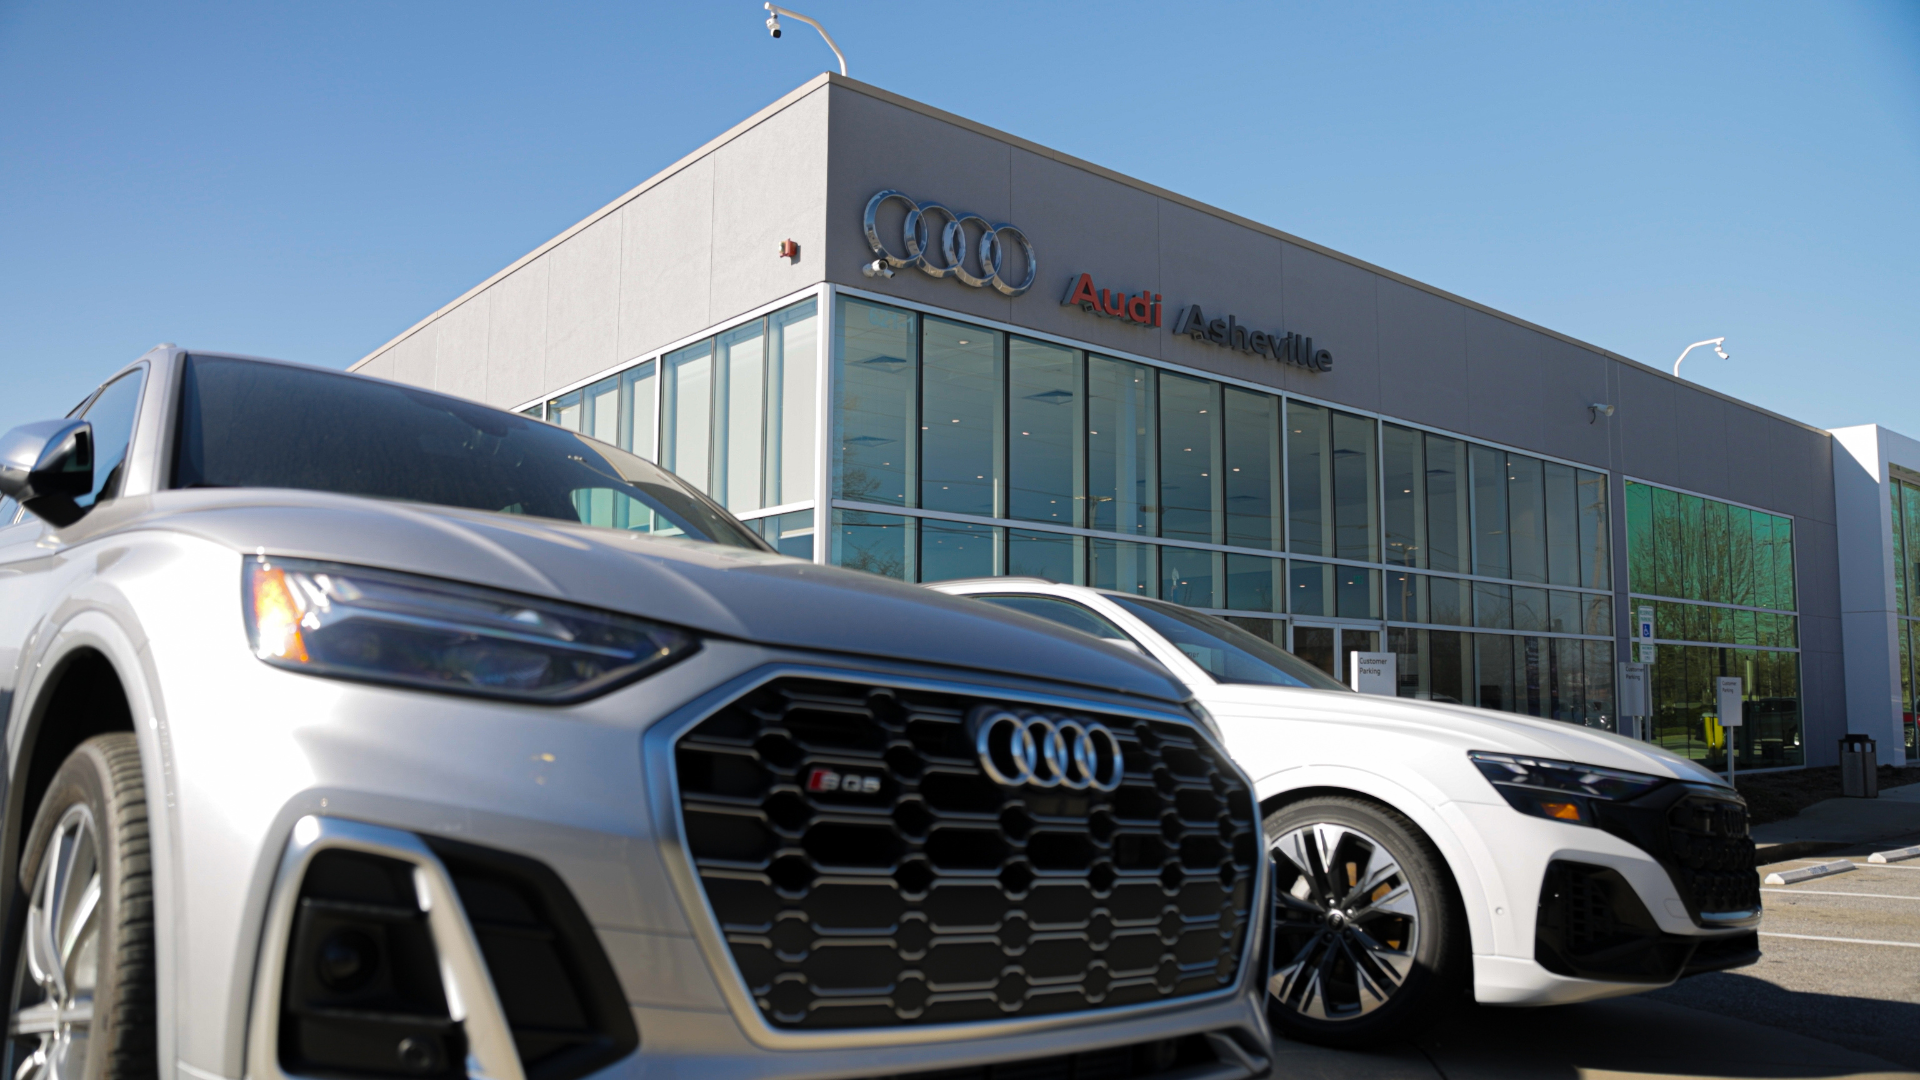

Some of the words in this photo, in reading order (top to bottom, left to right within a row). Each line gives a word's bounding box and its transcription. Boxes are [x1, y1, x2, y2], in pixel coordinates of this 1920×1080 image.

[1067, 272, 1162, 328] Audi
[1179, 304, 1333, 372] Asheville
[1359, 657, 1388, 665] Customer
[1359, 667, 1381, 676] Parking
